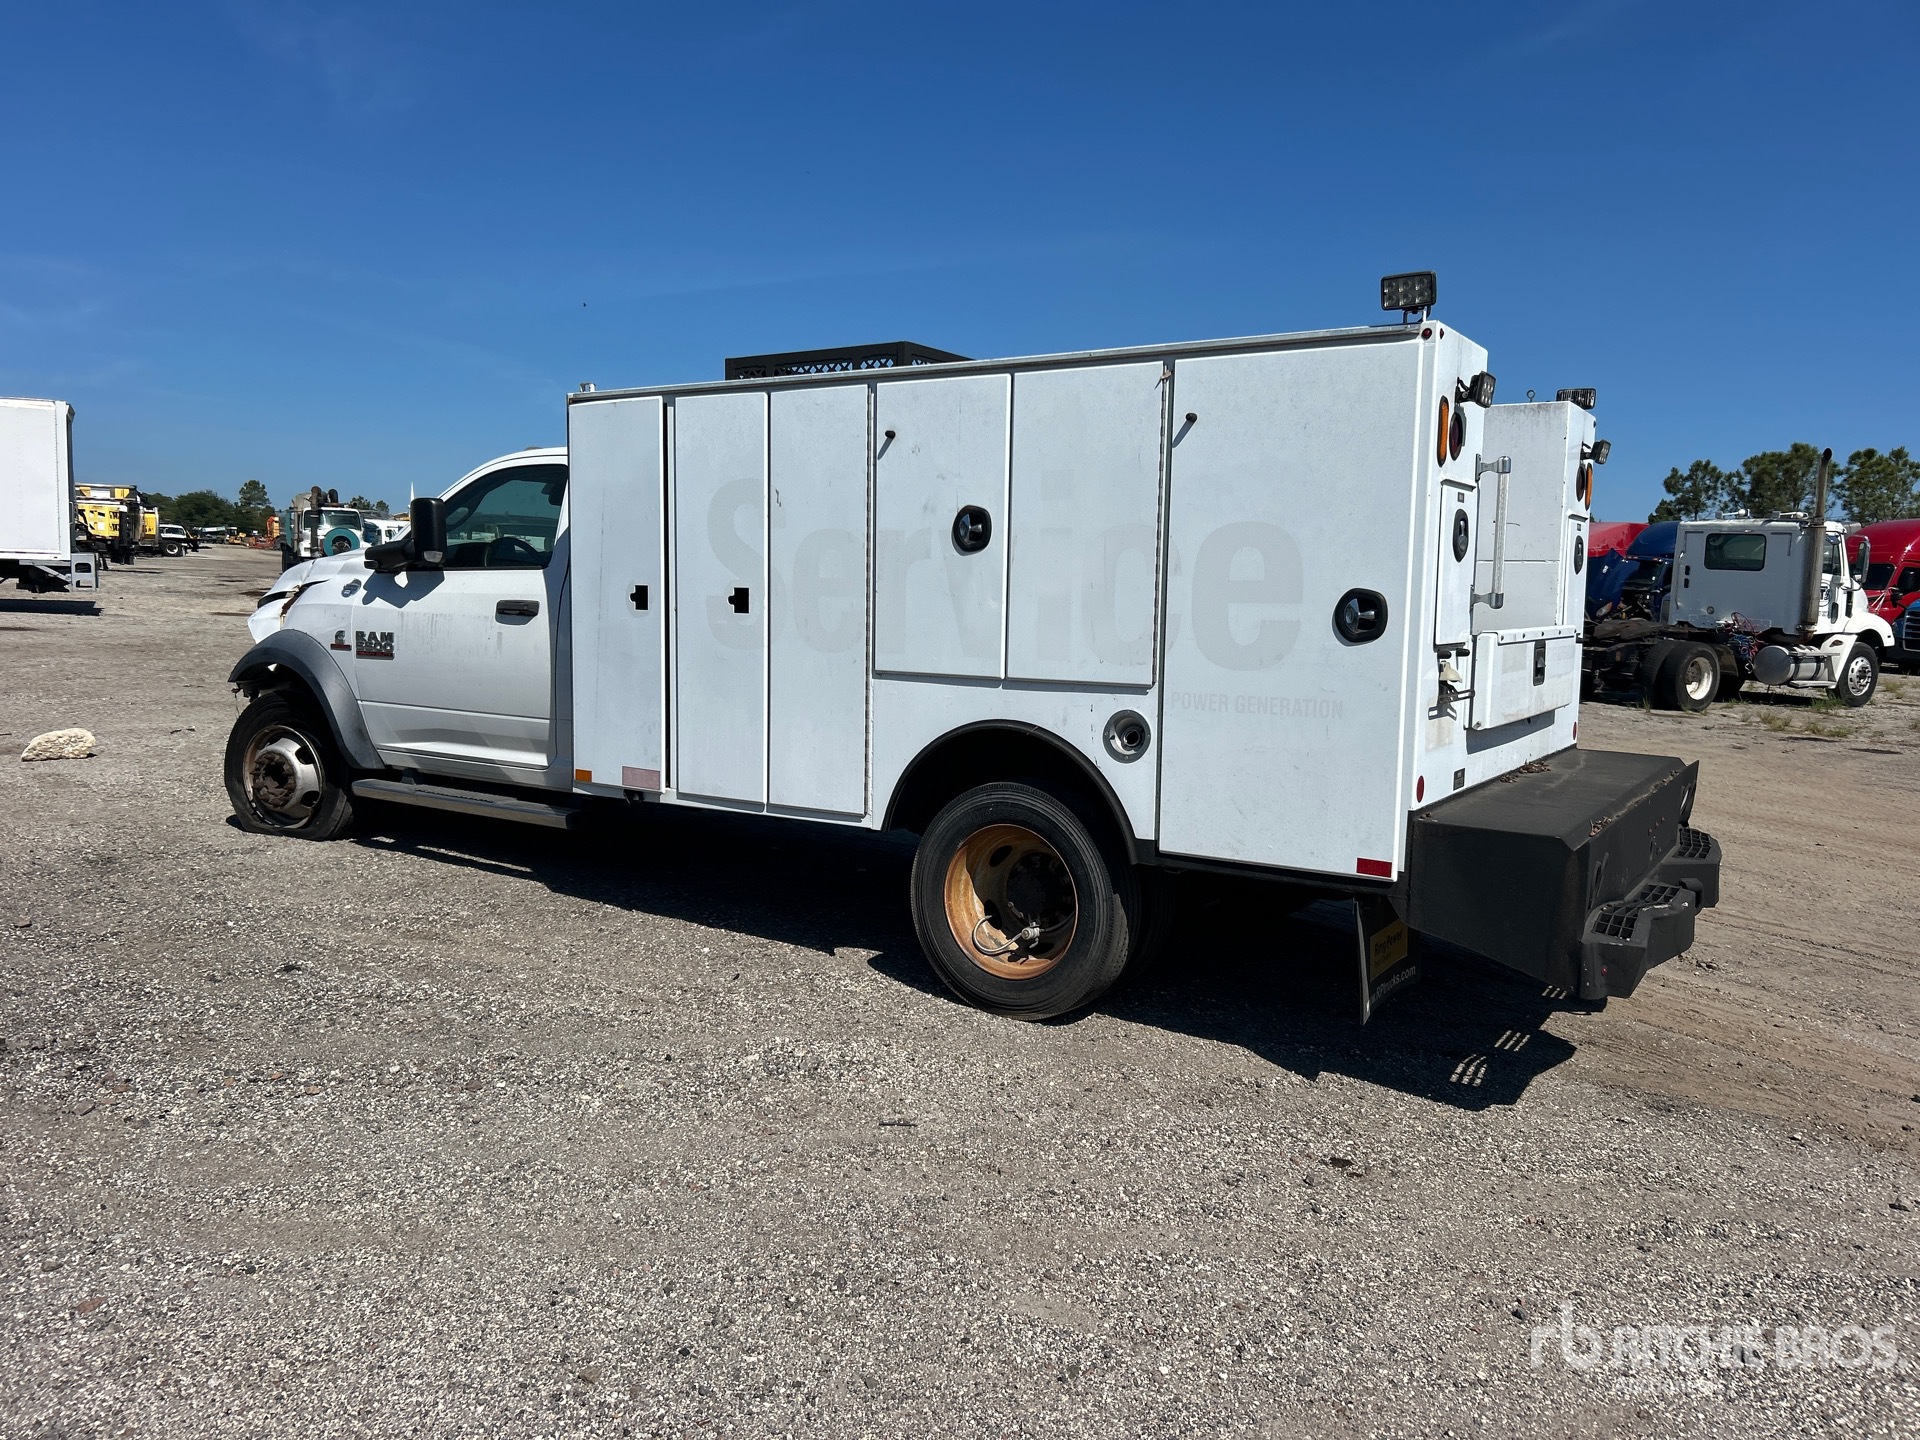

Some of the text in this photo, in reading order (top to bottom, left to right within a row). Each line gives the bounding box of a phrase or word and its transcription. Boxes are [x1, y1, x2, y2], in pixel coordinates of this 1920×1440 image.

[705, 469, 1304, 672] Service
[356, 631, 394, 643] RAM
[1170, 691, 1345, 719] POWER GENERATION
